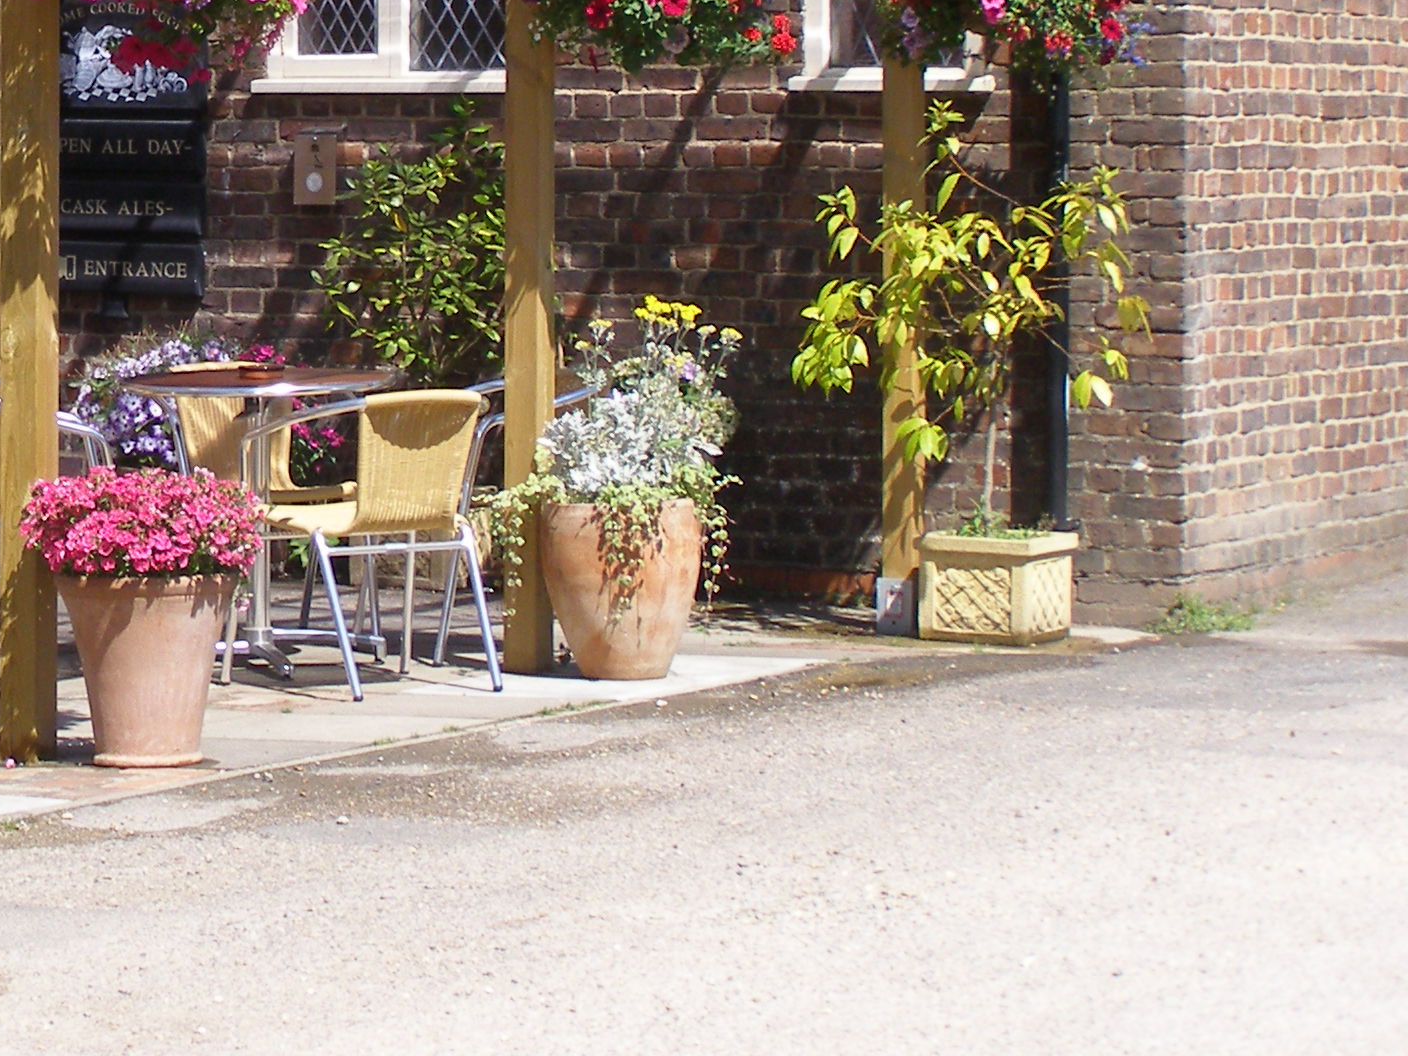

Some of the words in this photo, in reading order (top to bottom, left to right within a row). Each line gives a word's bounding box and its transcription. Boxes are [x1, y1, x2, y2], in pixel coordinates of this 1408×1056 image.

[59, 138, 91, 153] PEN
[102, 139, 138, 154] ALL
[60, 199, 108, 215] CASK
[84, 260, 188, 279] ENTRANCE
